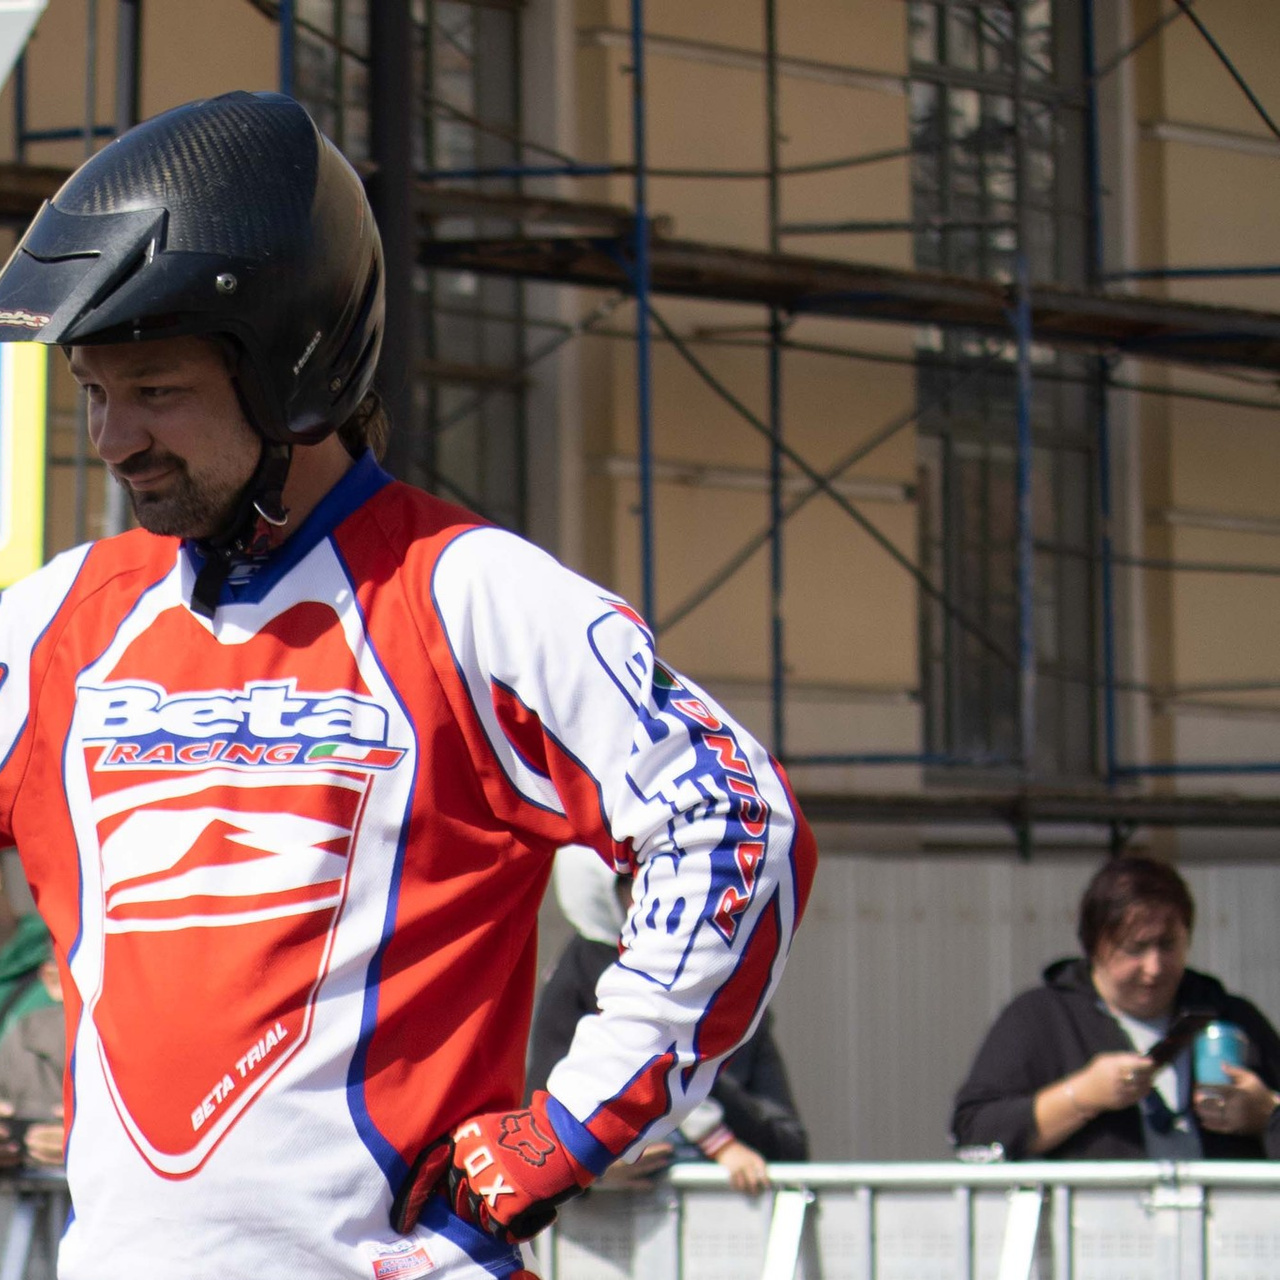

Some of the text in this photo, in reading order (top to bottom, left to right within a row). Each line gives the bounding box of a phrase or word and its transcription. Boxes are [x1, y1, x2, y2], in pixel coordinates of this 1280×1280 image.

[78, 682, 388, 742] Beta
[107, 740, 307, 766] RACING
[671, 698, 770, 940] RACING
[189, 1022, 288, 1132] BETA TRIAL
[453, 1121, 515, 1208] FOX
